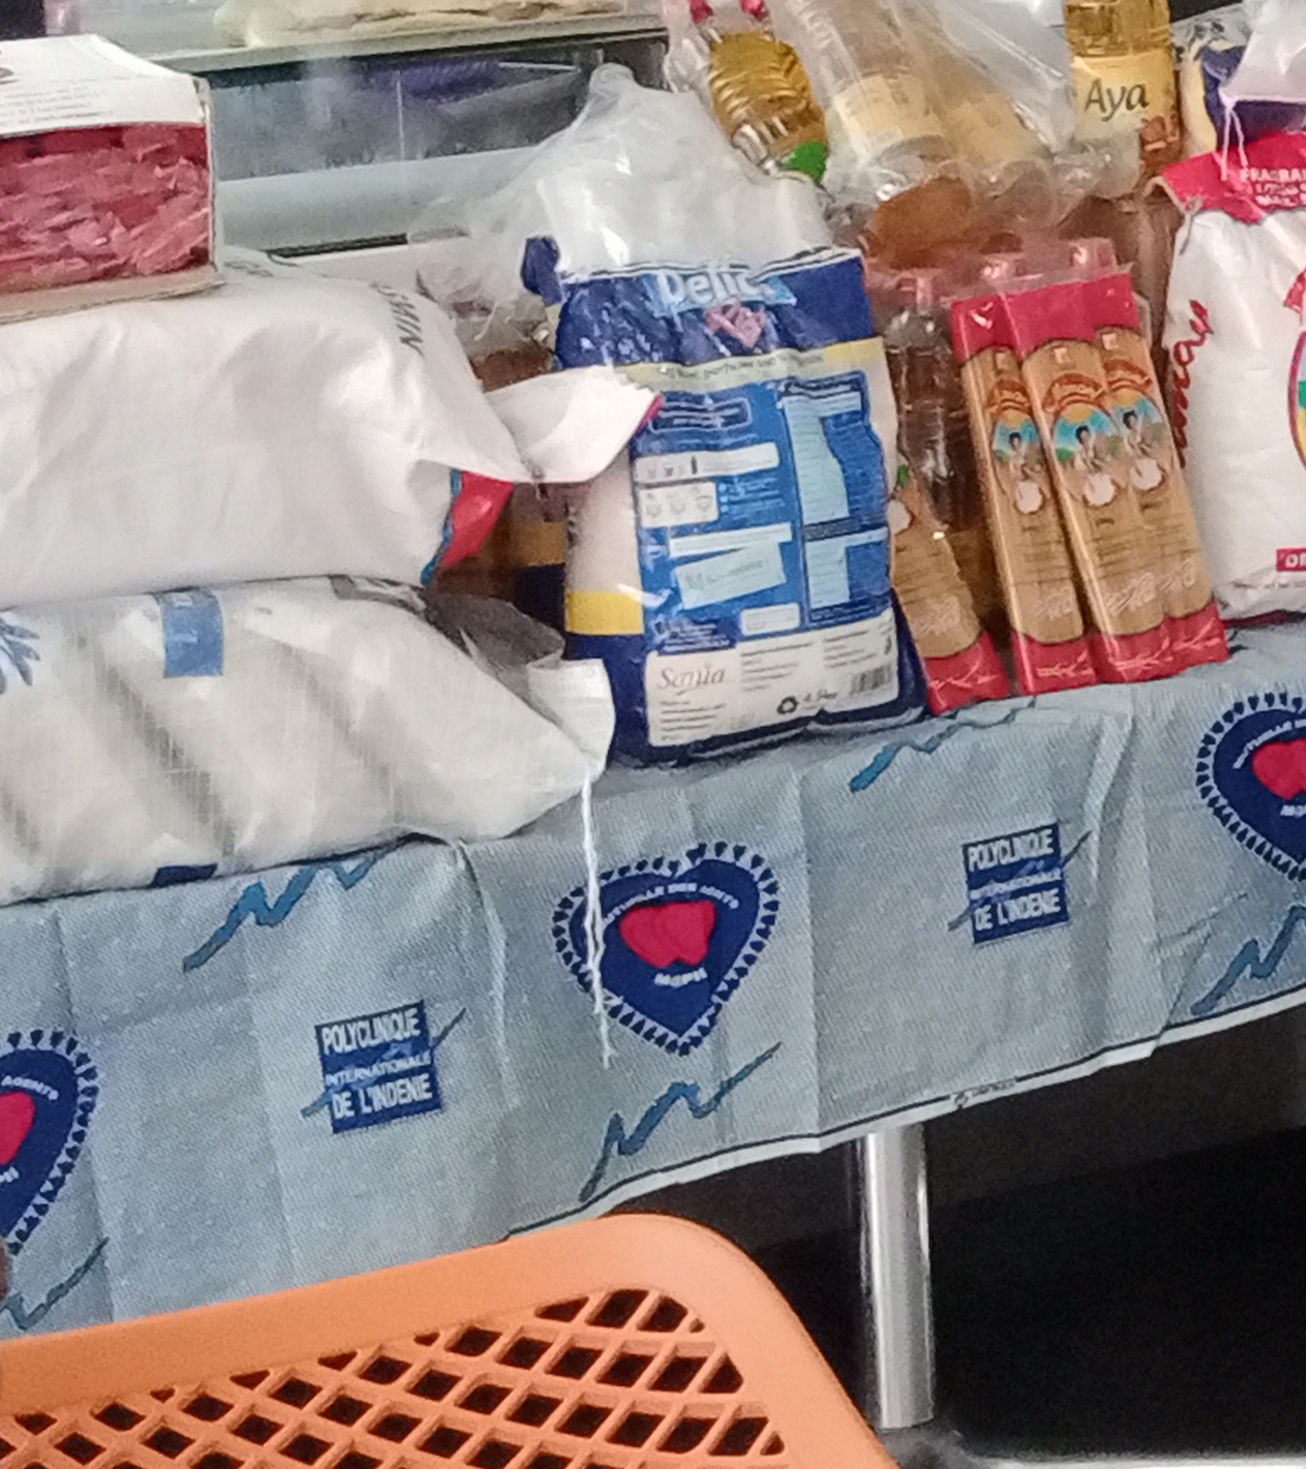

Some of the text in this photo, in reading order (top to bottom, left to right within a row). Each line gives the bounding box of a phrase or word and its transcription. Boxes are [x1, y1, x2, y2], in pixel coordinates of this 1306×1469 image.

[1085, 78, 1148, 121] Aya
[321, 1007, 422, 1056] POLYCLINIQUE
[332, 1091, 355, 1120] DE
